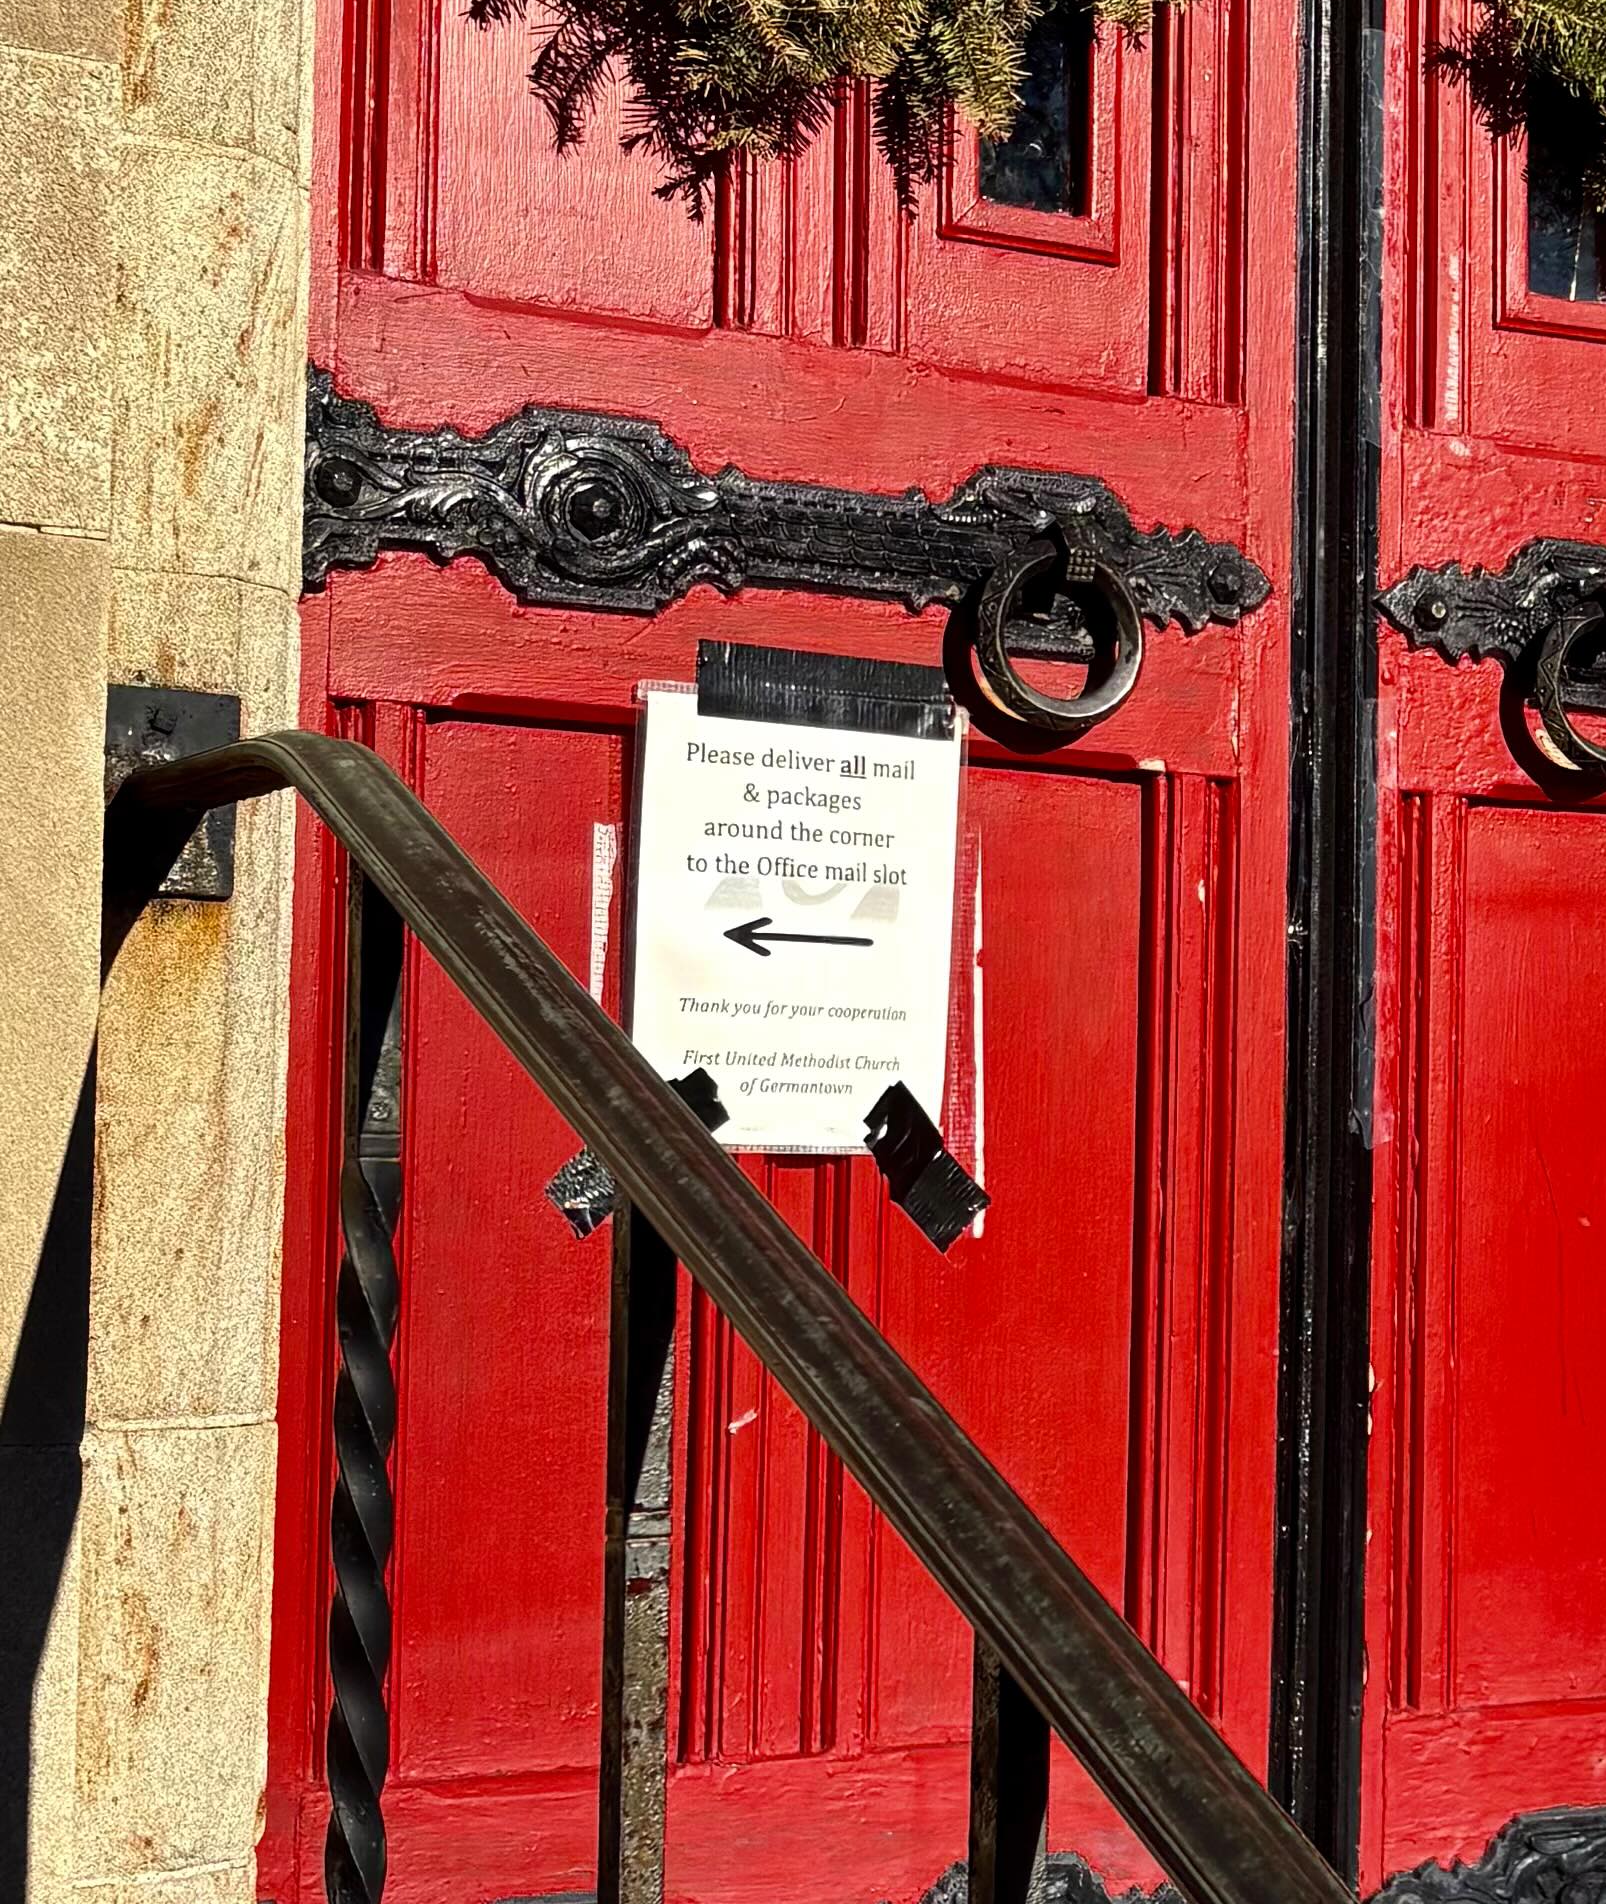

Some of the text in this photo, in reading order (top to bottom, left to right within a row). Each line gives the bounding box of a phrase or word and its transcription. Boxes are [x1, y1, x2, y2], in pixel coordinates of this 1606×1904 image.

[686, 741, 915, 781] Please deliver all mail
[743, 782, 862, 815] & packages
[703, 819, 896, 849] around the corner
[686, 852, 908, 886] to the Office mail slot
[679, 997, 907, 1022] Thank you for your cooperation
[682, 1049, 901, 1071] First United Methodist Church
[739, 1077, 853, 1097] of Germantown
